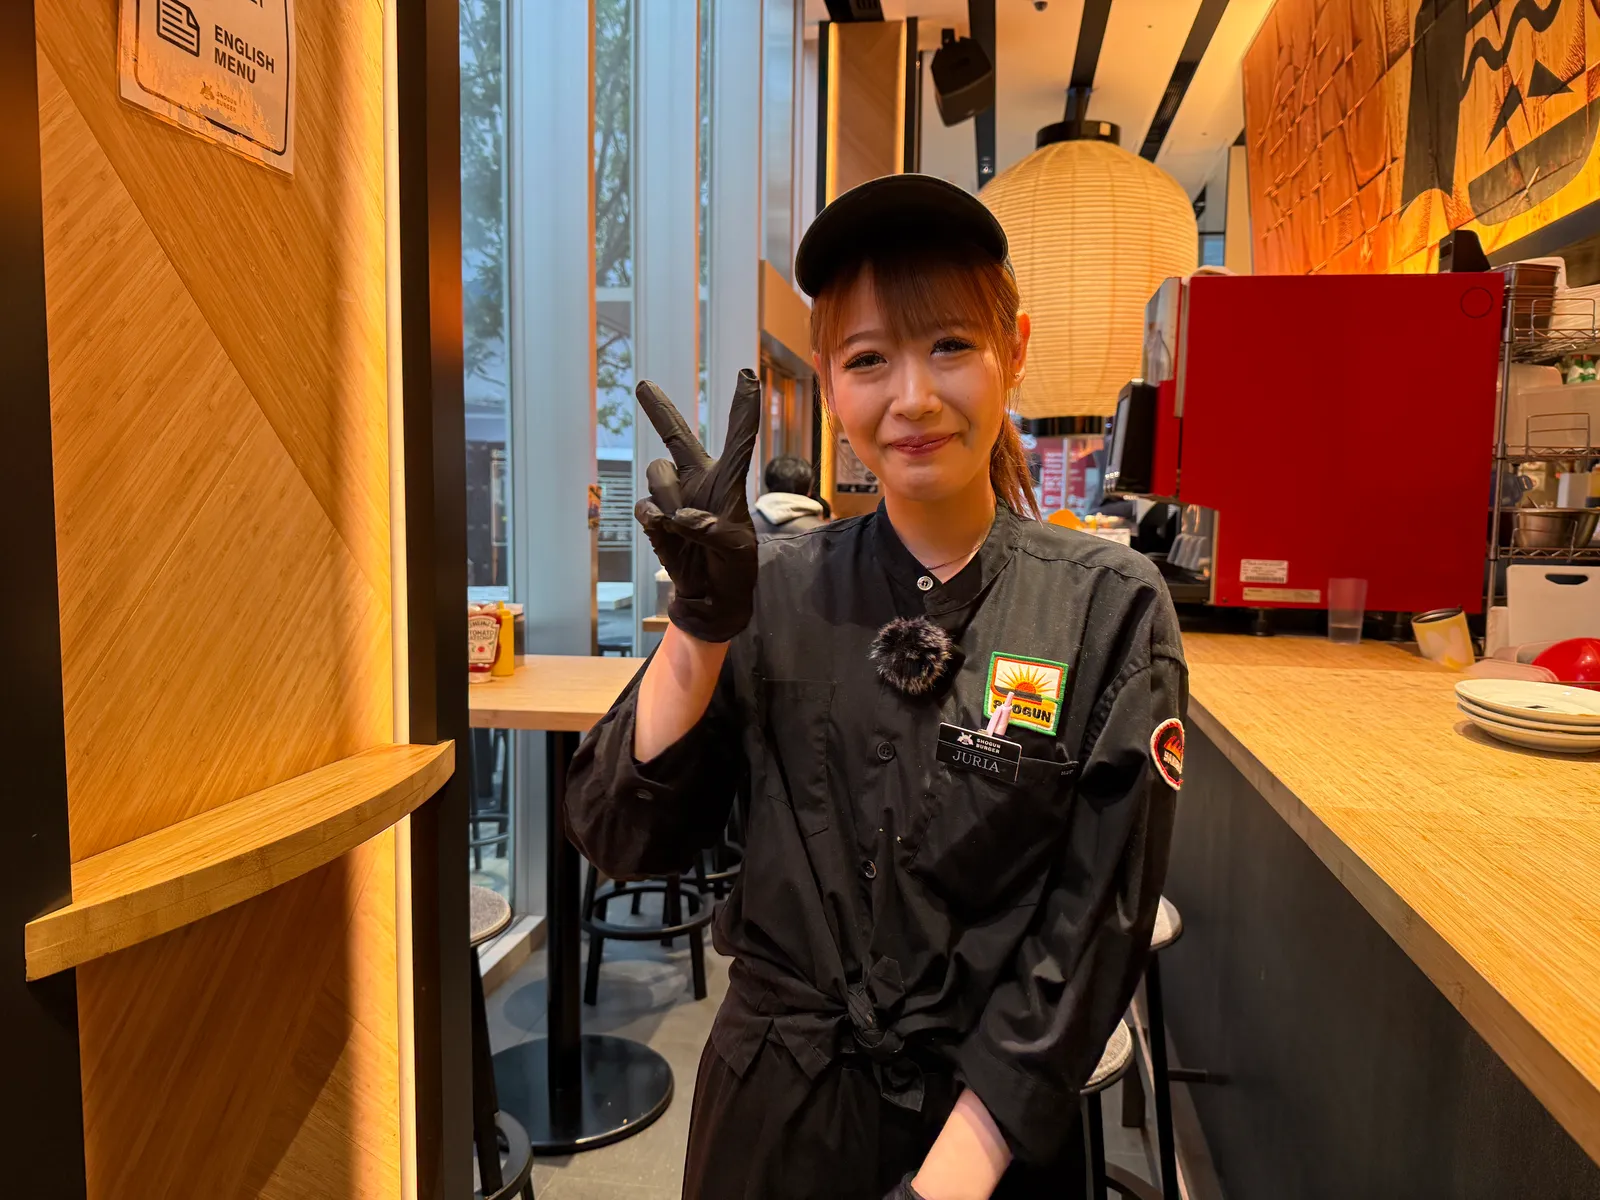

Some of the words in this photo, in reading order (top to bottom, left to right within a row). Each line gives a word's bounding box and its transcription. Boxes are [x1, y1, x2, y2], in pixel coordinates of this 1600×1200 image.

[214, 24, 275, 74] ENGLISH
[214, 47, 256, 84] MENU
[993, 699, 1052, 723] SOGUN
[975, 743, 1000, 754] BURGER
[976, 738, 1001, 749] SHOGUN
[952, 750, 1000, 773] JURIA
